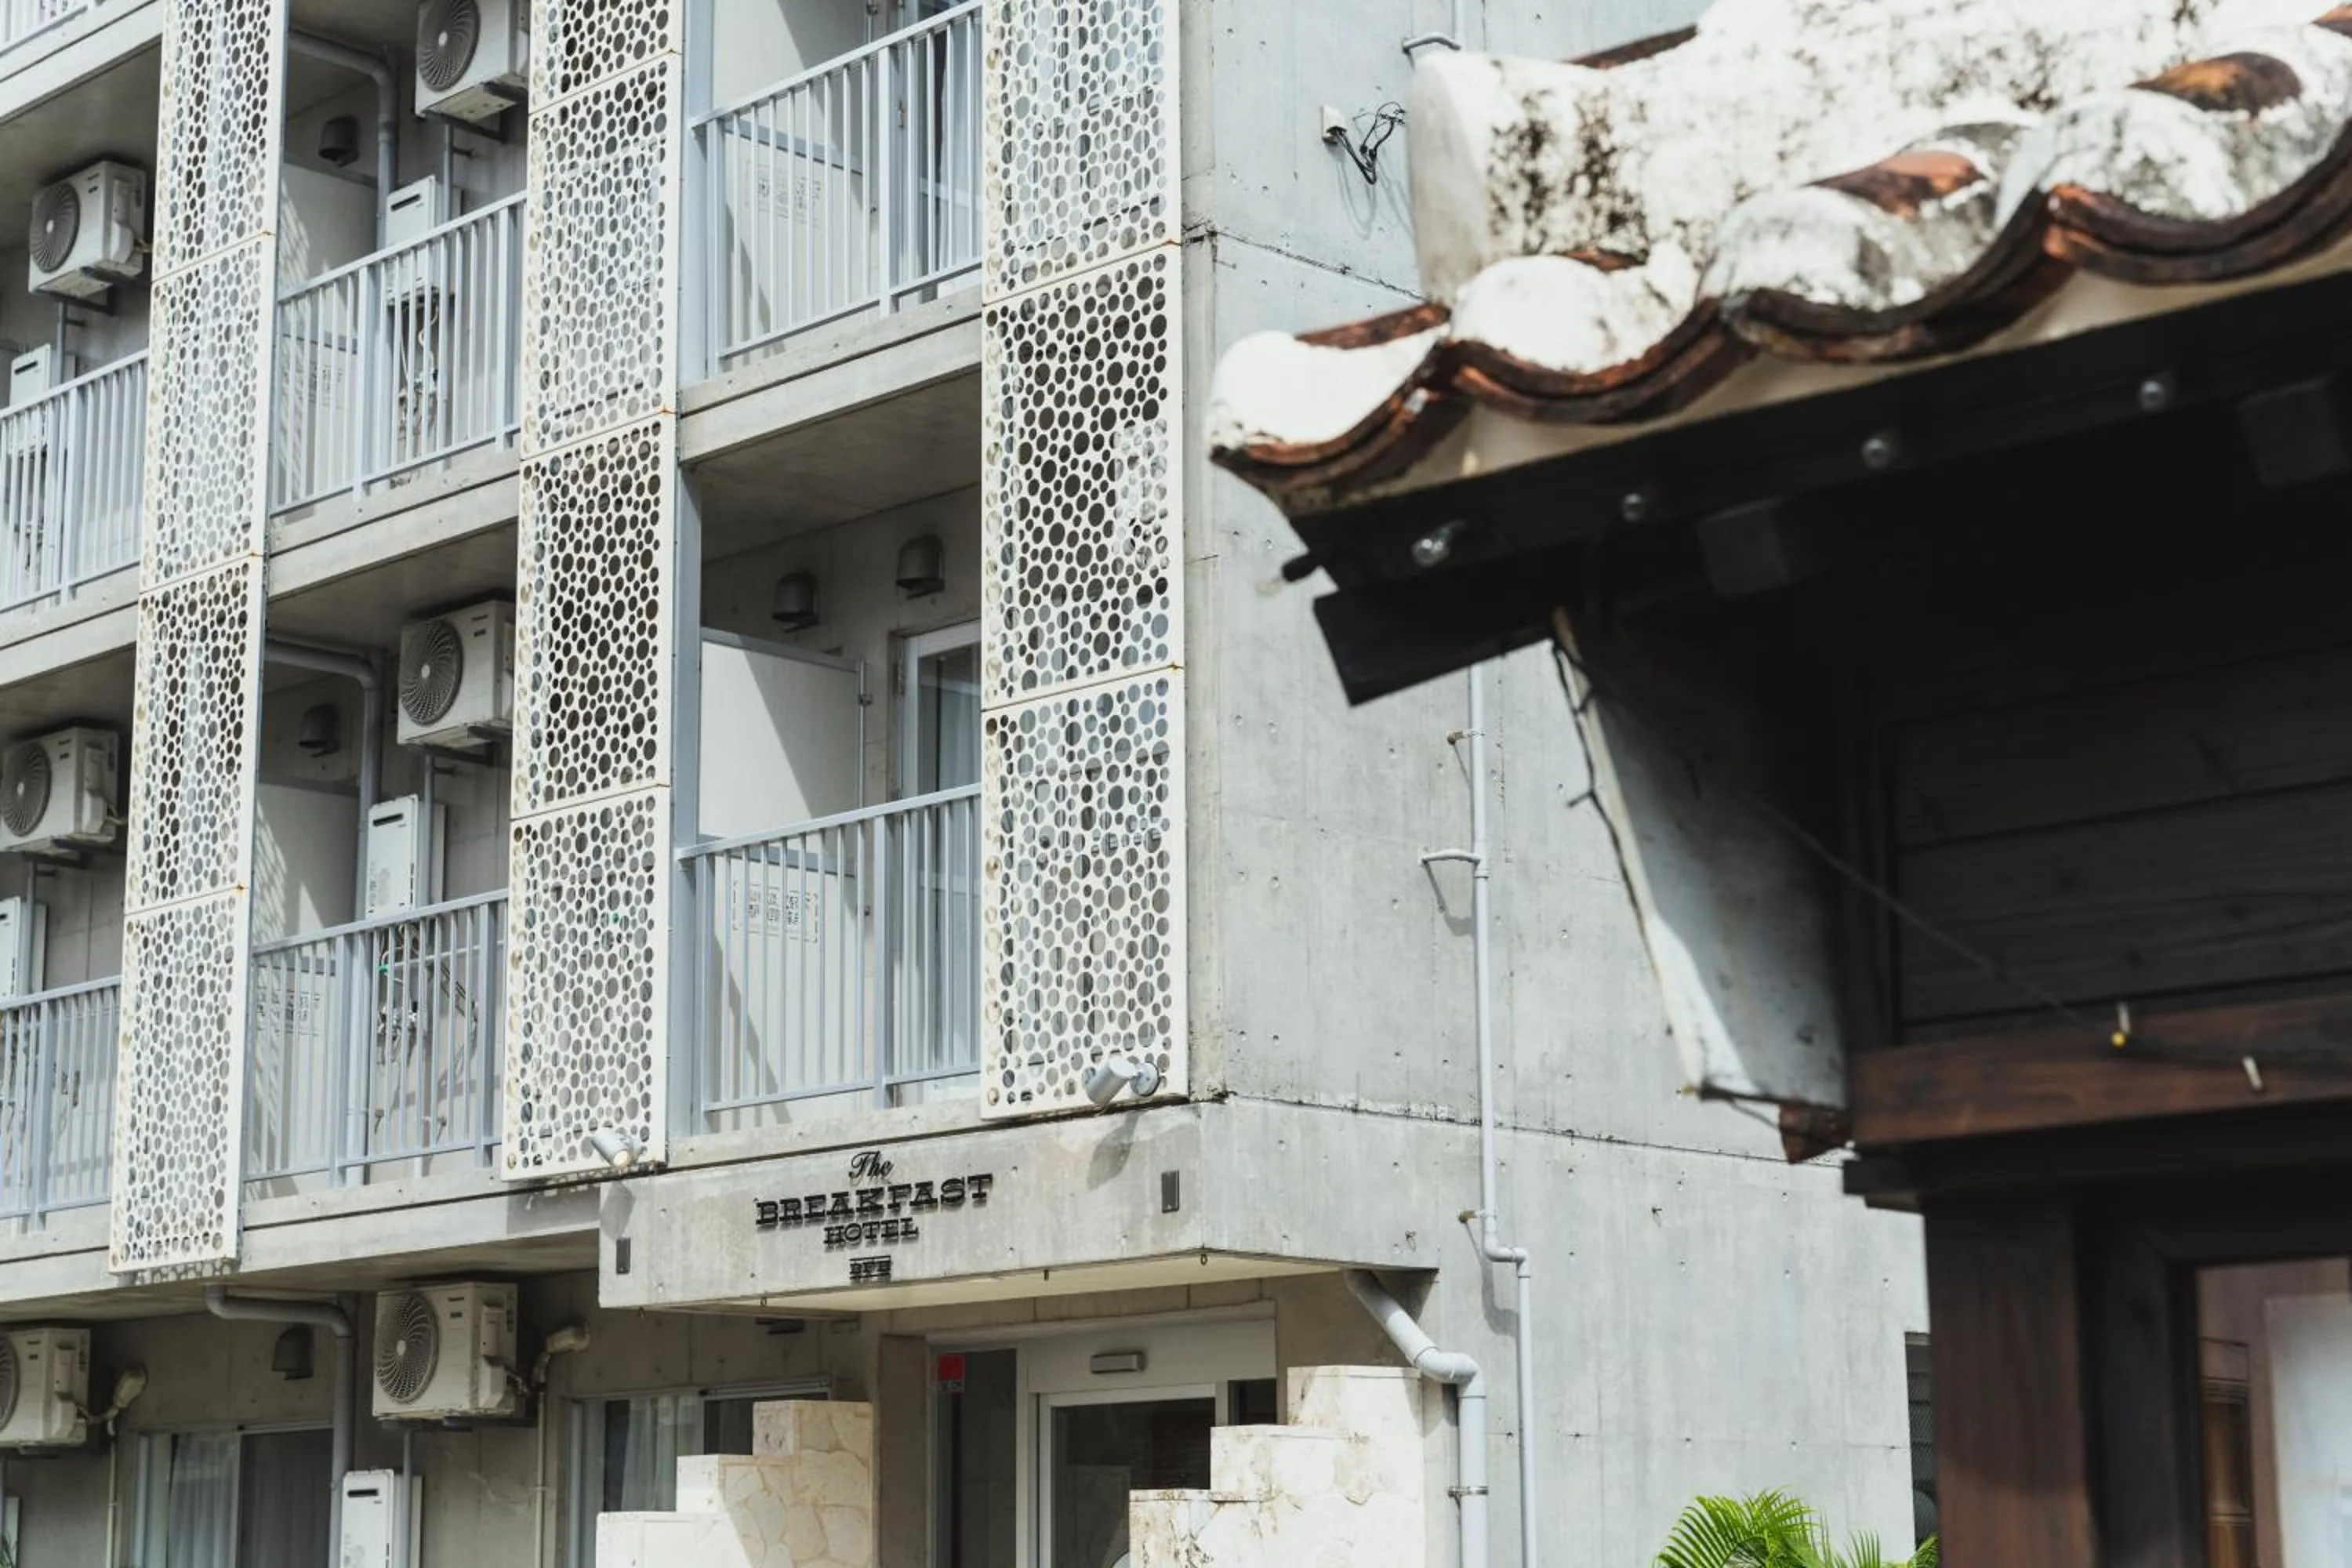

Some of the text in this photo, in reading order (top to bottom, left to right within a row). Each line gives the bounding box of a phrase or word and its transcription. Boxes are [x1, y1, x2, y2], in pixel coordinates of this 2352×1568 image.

[848, 1150, 895, 1178] The
[755, 1173, 993, 1225] BREAKFAST
[823, 1217, 918, 1244] HOTEL
